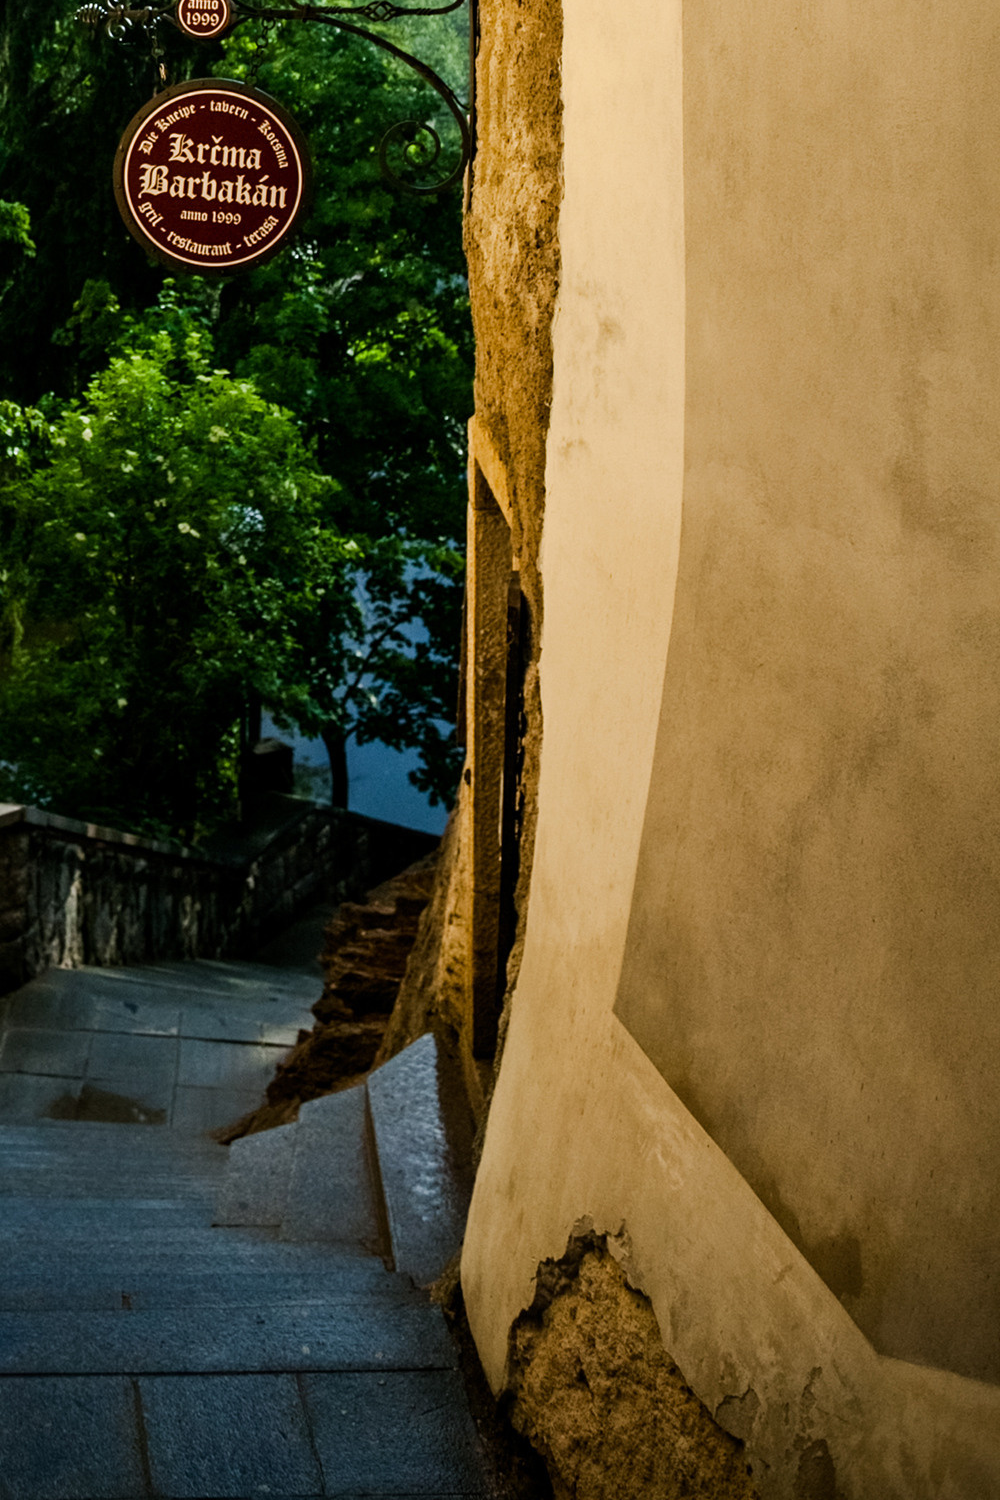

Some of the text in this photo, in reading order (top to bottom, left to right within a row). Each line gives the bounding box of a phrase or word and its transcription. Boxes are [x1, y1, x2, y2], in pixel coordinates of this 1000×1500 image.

[186, 11, 220, 27] 1999
[138, 131, 159, 155] Die
[154, 104, 197, 133] Kneipe
[210, 99, 249, 120] tavern
[257, 119, 289, 169] Kocsma
[168, 132, 262, 170] Krčma
[138, 163, 288, 209] Barbakán
[137, 201, 164, 227] gril
[166, 231, 232, 257] restaurant
[243, 215, 279, 248] terasa
[180, 209, 242, 225] anno 1999
